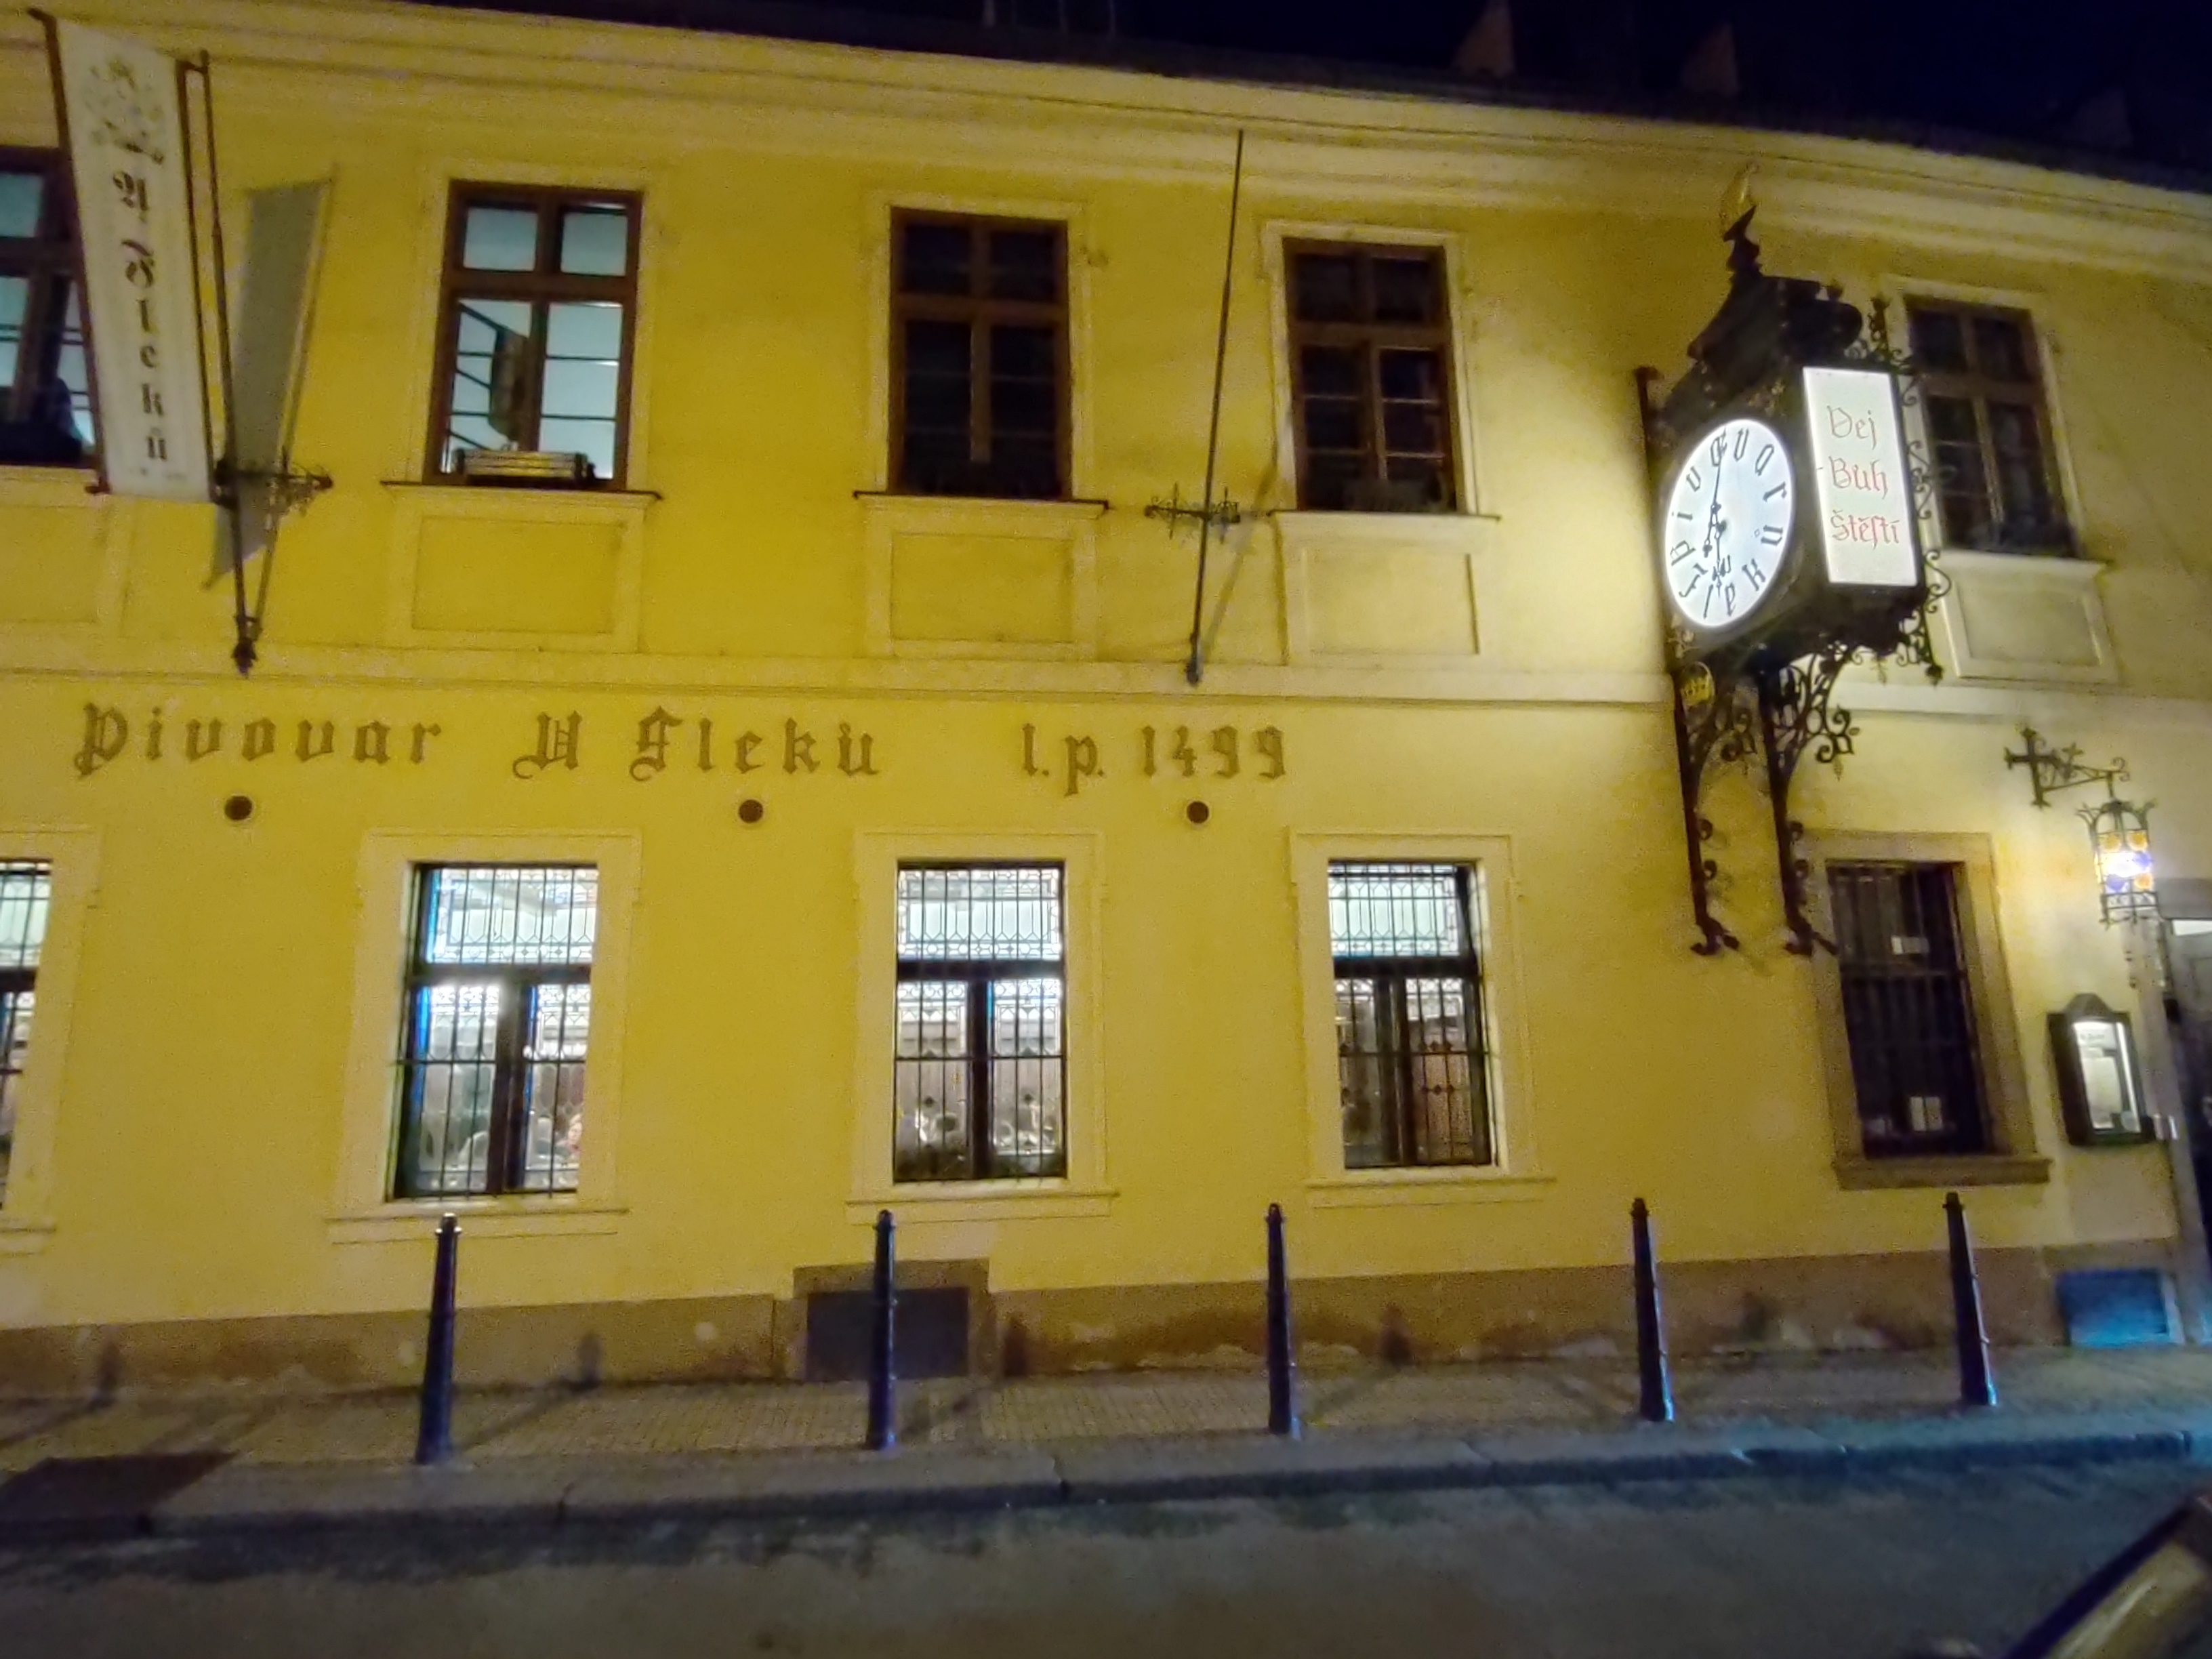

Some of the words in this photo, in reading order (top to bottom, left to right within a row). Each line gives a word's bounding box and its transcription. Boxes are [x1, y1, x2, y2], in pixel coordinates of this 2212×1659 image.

[1826, 405, 1877, 451] Dej
[75, 702, 442, 781] Pivovar
[1141, 725, 1286, 779] 1499
